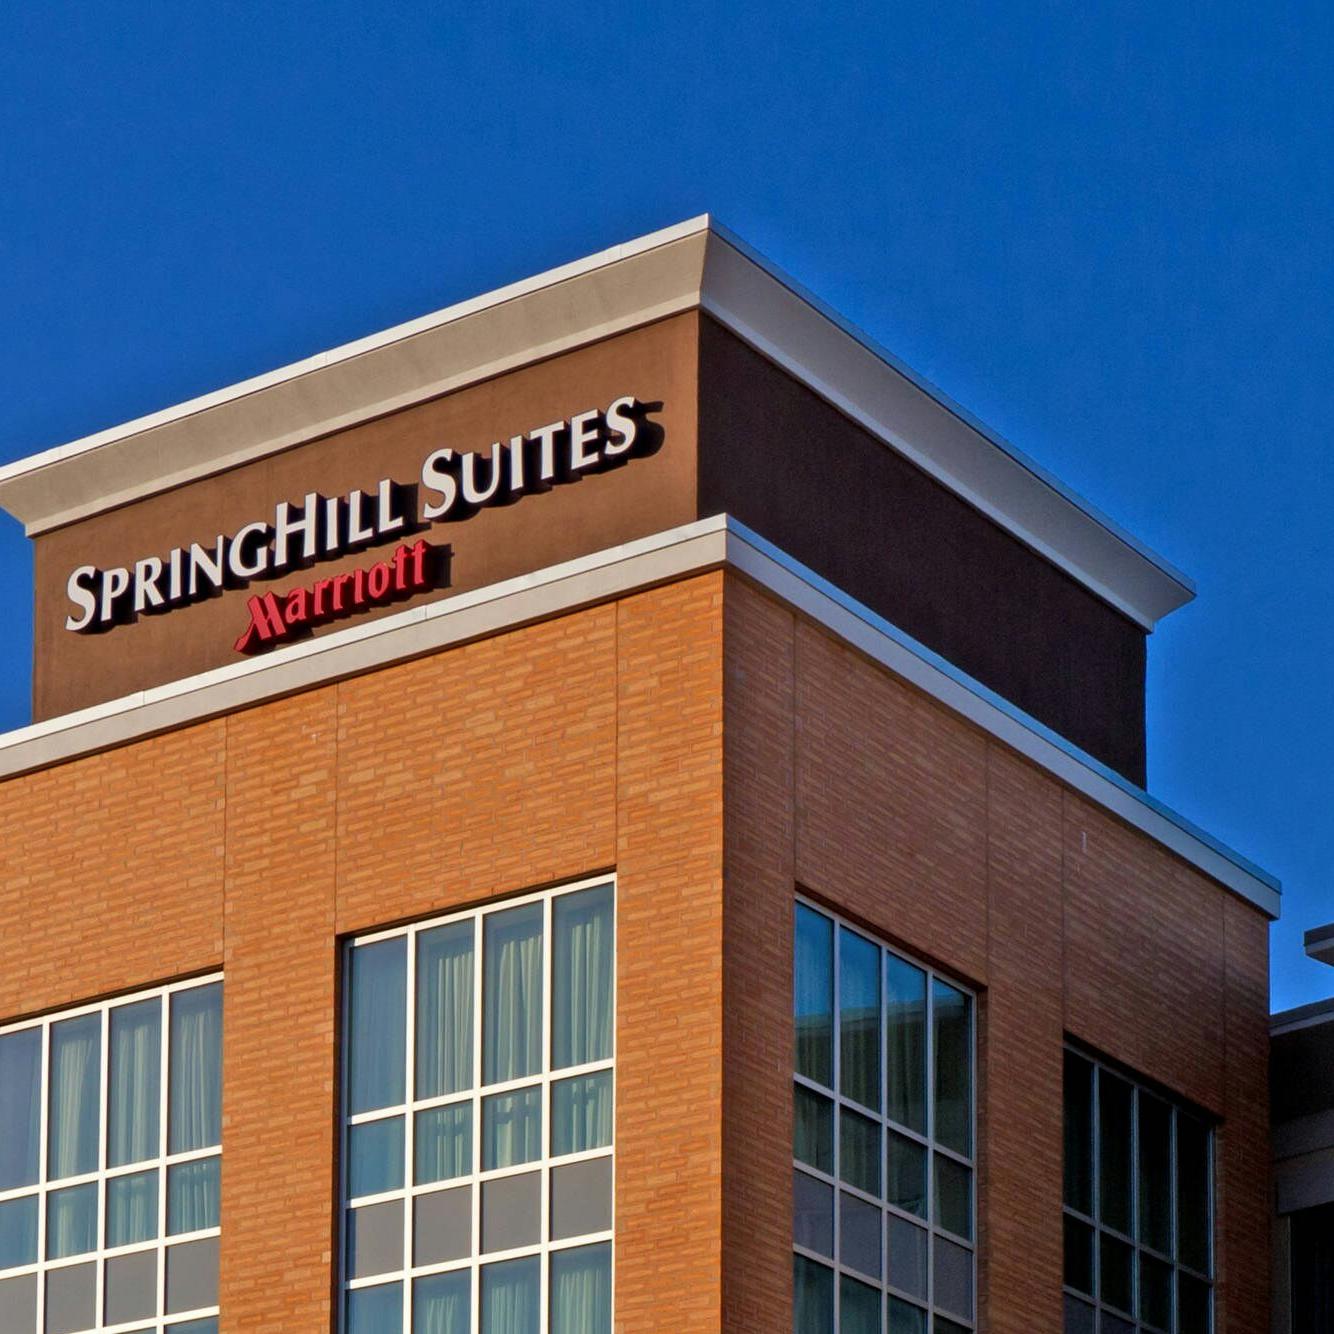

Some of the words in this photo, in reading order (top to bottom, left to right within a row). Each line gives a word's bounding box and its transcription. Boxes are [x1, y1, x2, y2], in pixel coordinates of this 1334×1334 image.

[66, 477, 403, 632] SPRINGHILL
[421, 397, 635, 519] SUITES
[233, 538, 428, 652] Marriott
